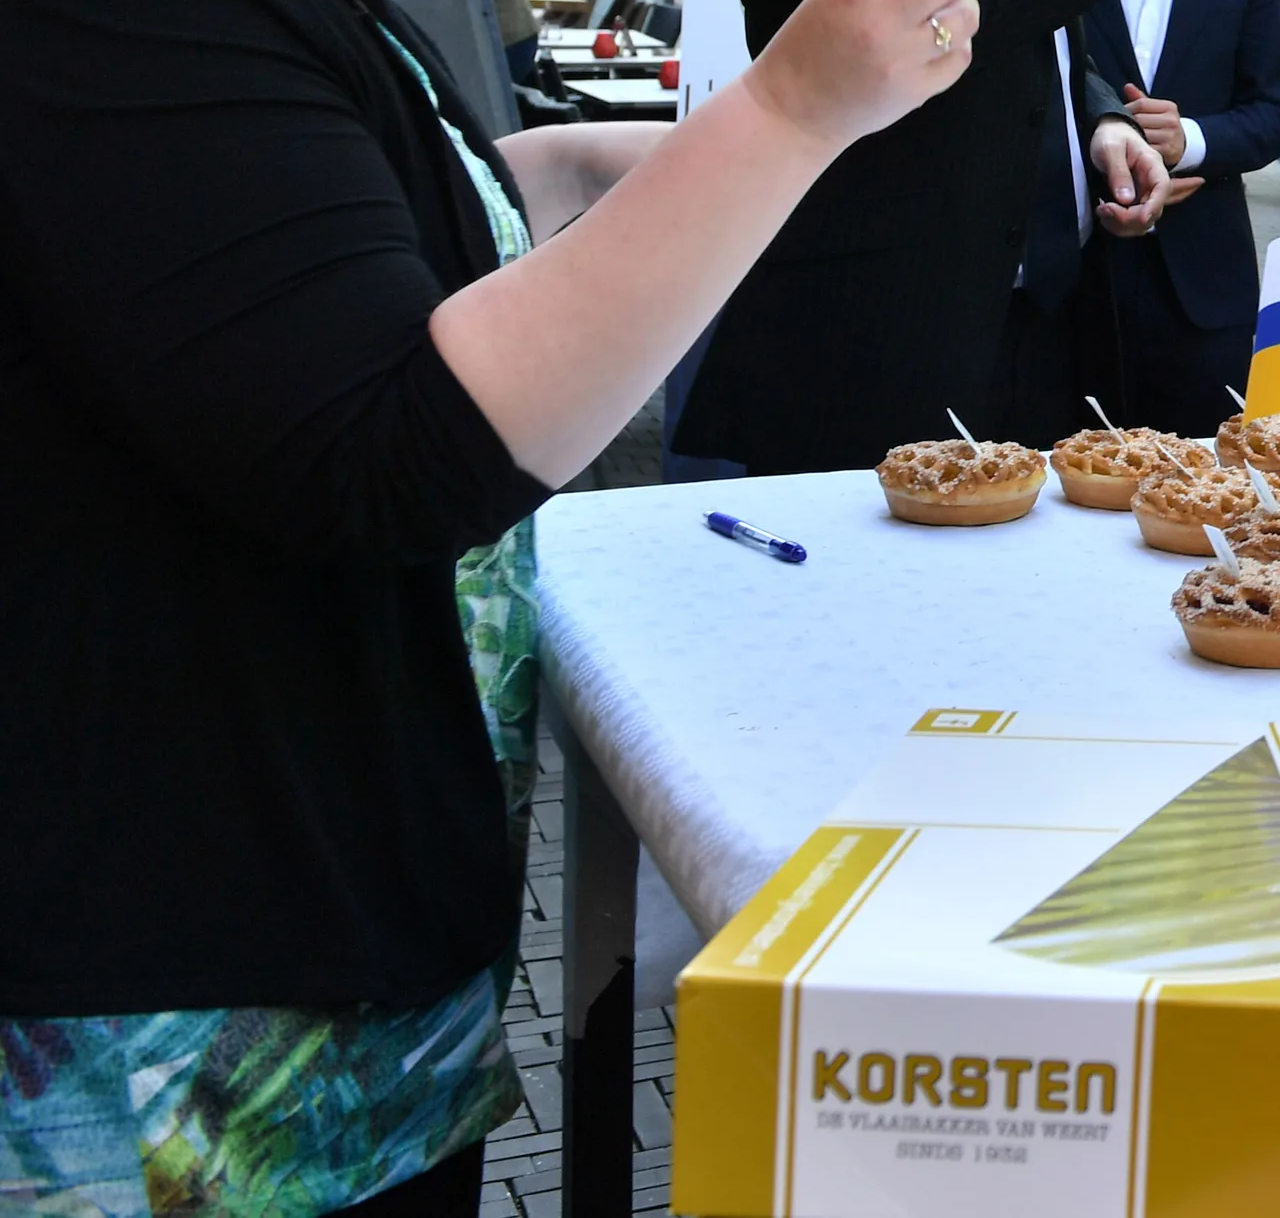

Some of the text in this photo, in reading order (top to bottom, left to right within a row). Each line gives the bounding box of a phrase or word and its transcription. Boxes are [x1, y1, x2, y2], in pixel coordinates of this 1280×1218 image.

[811, 1049, 1118, 1115] KORSTEN
[816, 1112, 844, 1130] DE
[996, 1121, 1035, 1138] VAN
[1041, 1123, 1110, 1141] WEERT
[896, 1142, 963, 1161] SINDS
